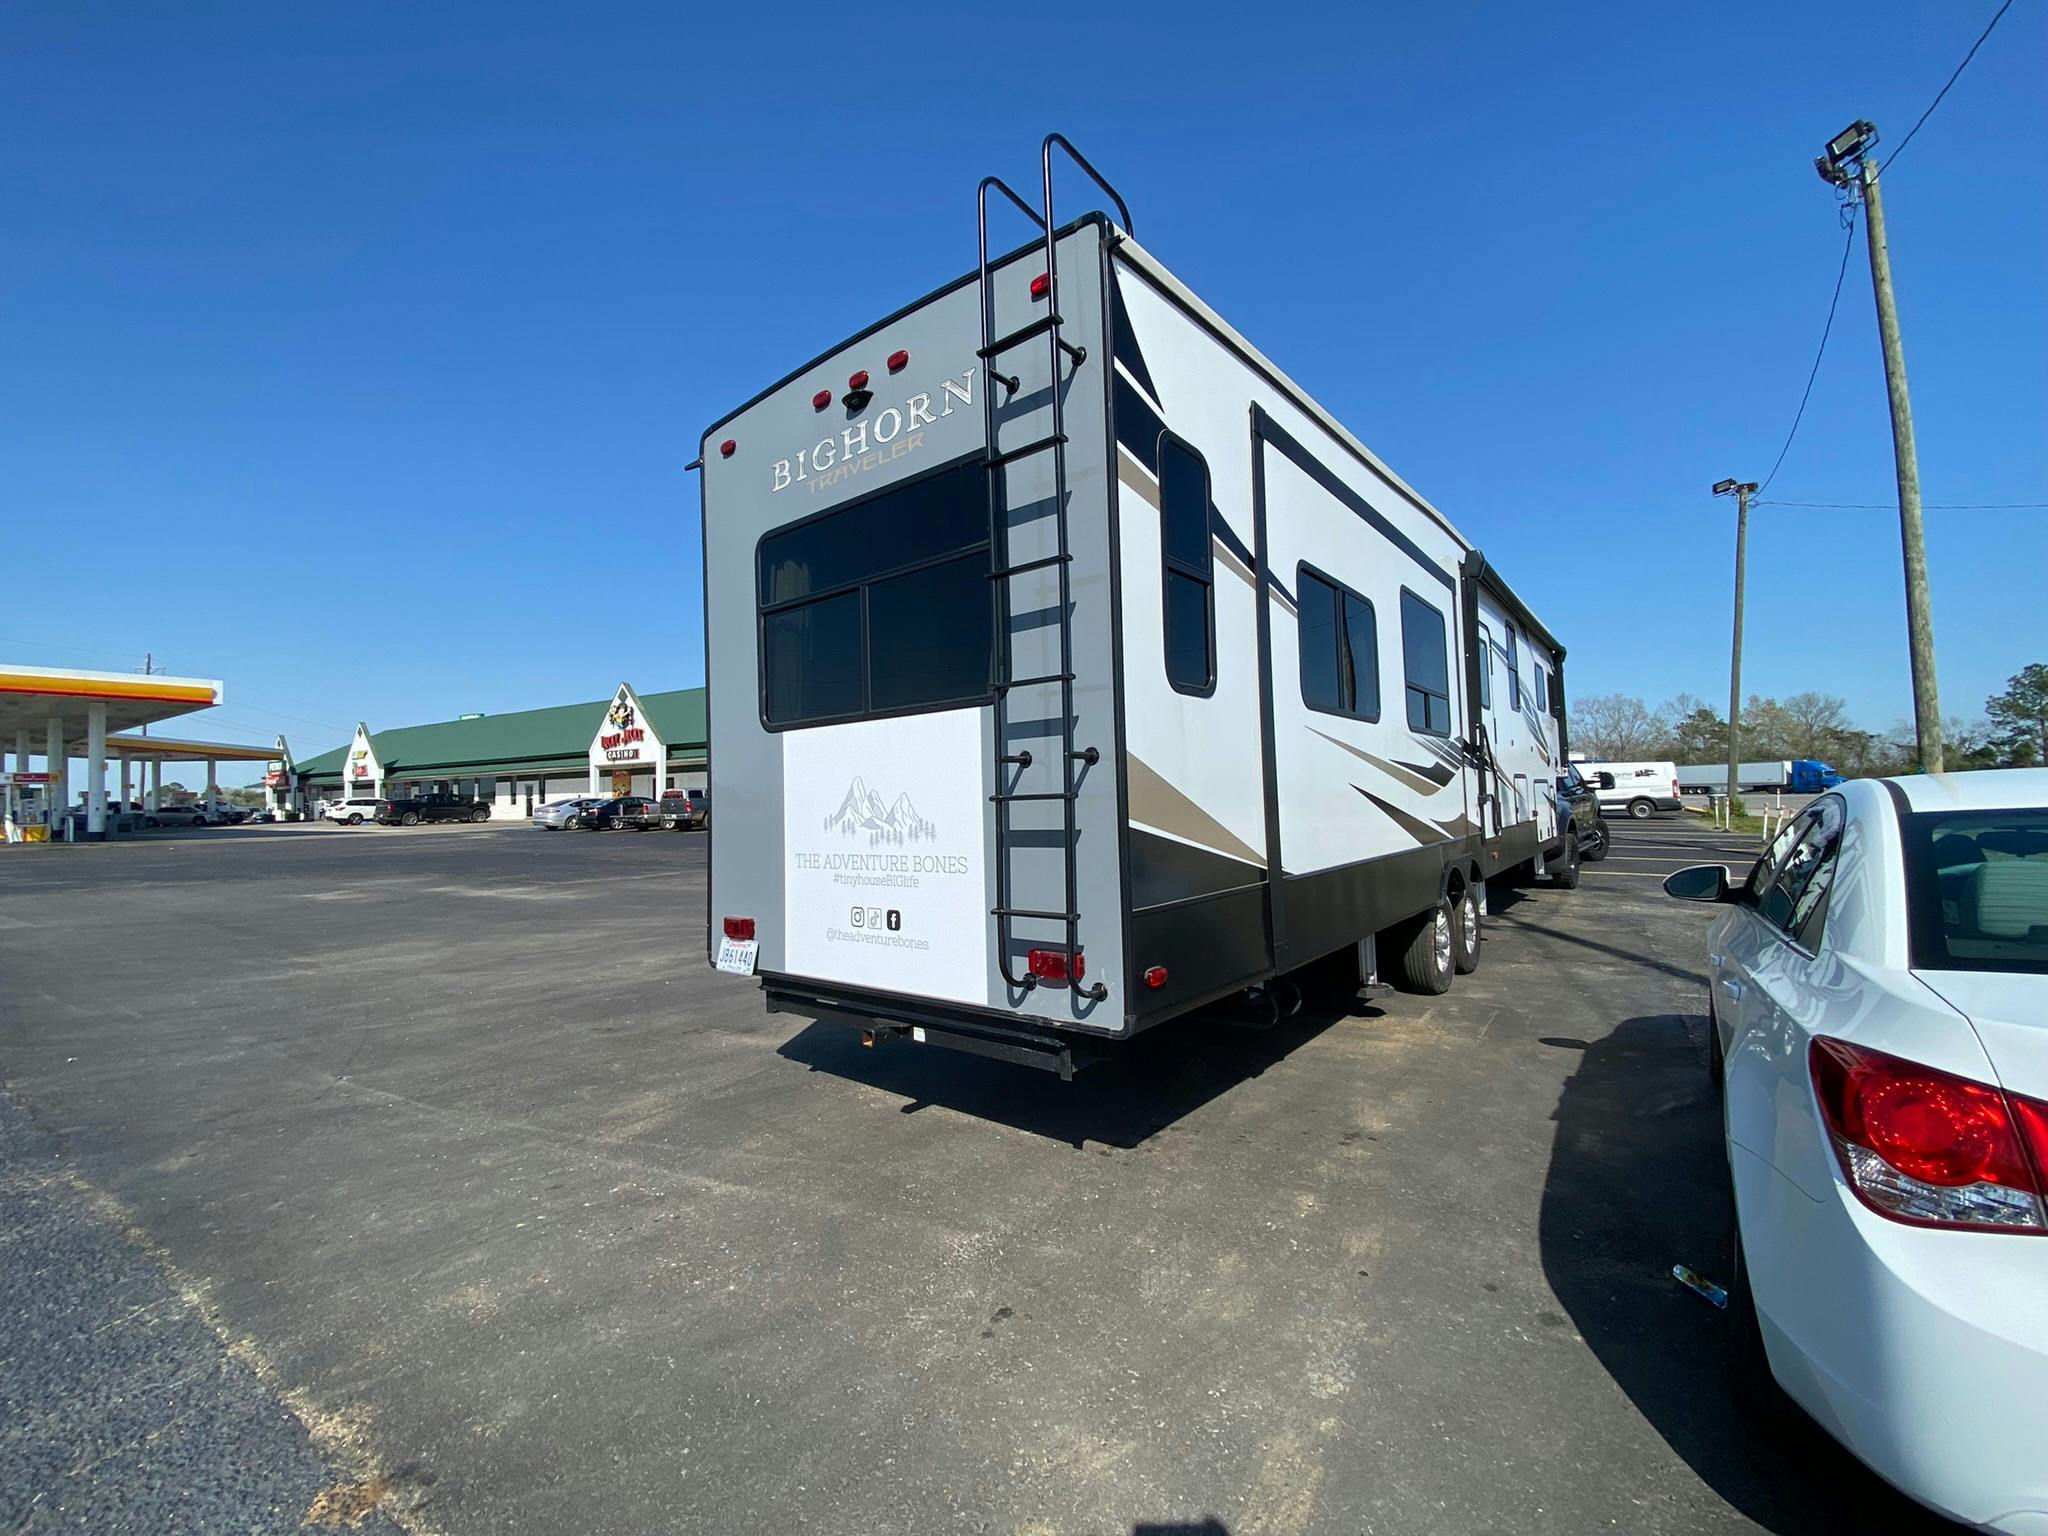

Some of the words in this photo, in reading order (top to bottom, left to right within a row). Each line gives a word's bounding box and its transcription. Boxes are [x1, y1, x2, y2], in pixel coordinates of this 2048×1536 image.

[772, 367, 976, 493] BIGHORN
[806, 432, 925, 495] TRAVELER
[607, 750, 635, 760] CASINO
[795, 853, 821, 869] THE
[823, 854, 909, 872] ADVENTURE
[913, 856, 969, 874] BONES
[833, 873, 920, 888] #tinyhouseBIGlife
[826, 927, 930, 950] @theadventurebones
